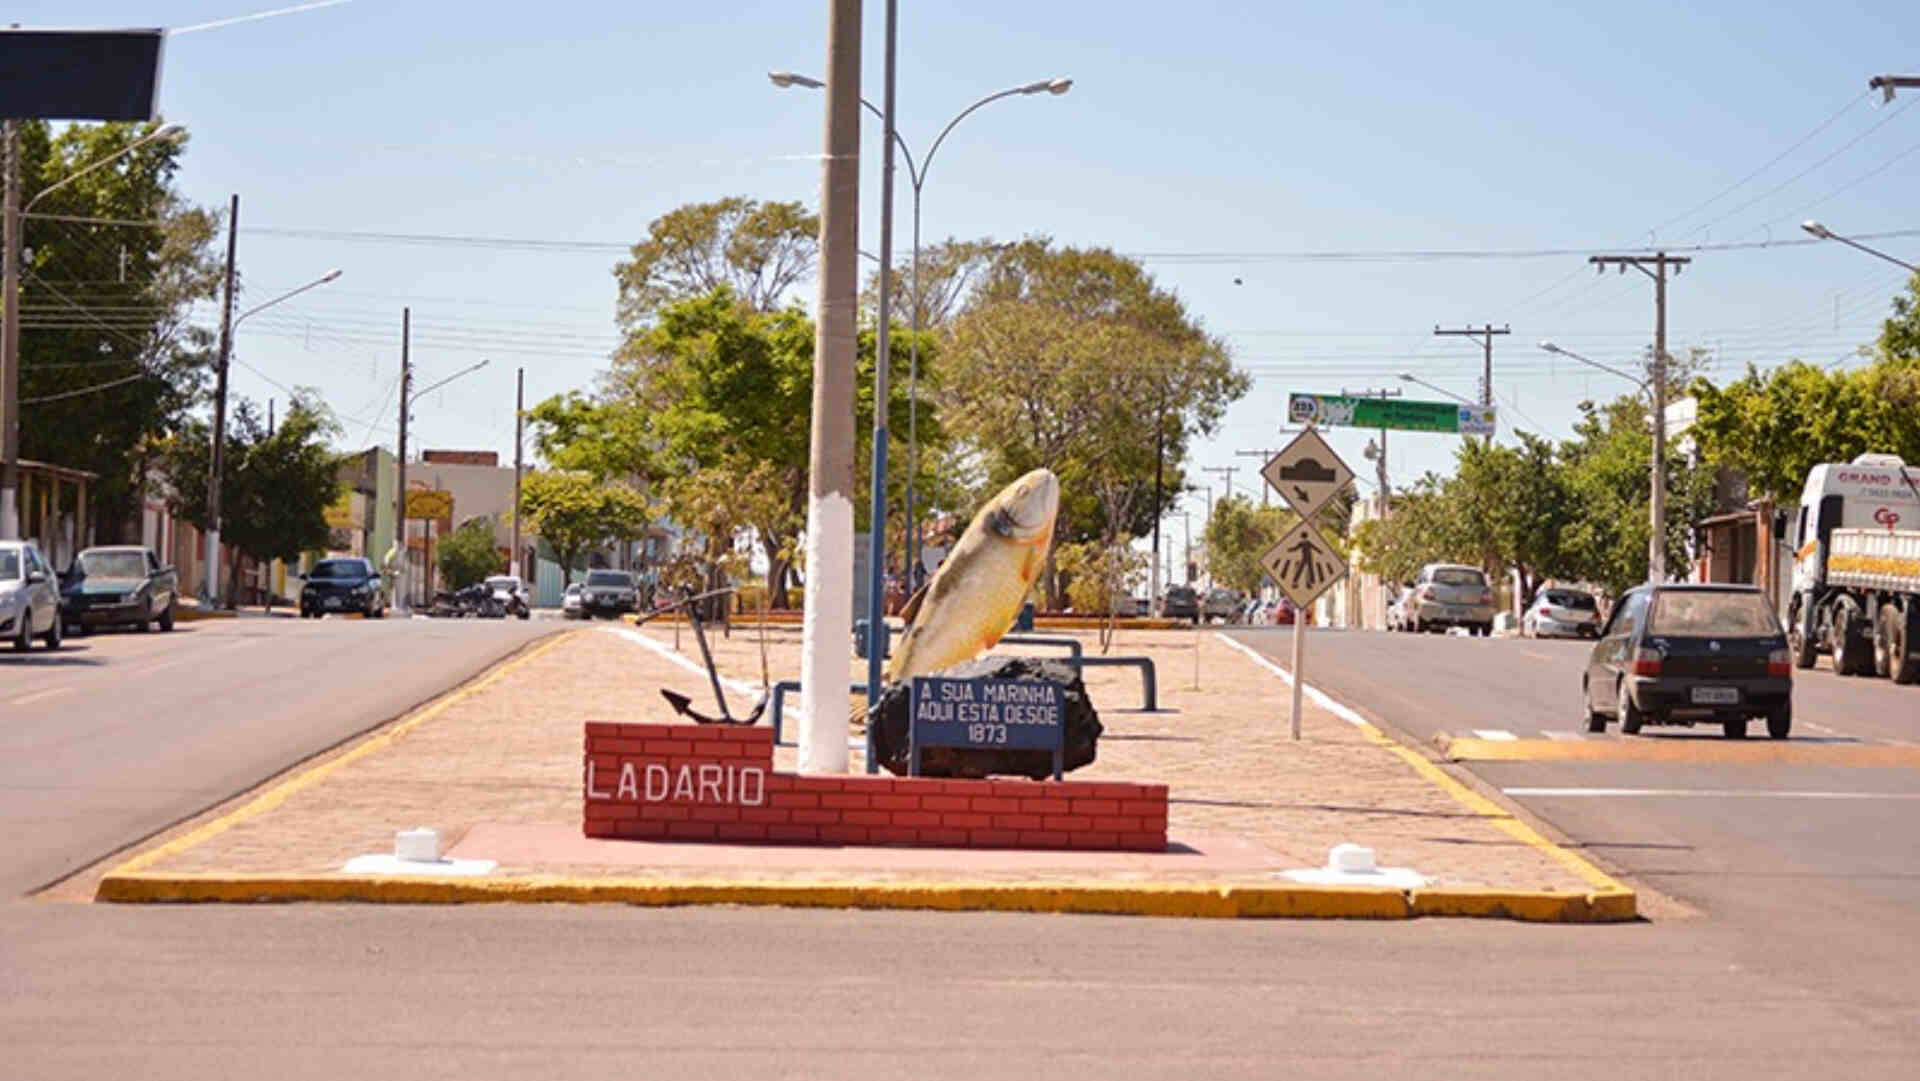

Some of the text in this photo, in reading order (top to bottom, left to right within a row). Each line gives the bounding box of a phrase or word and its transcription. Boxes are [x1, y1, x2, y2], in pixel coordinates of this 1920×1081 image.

[921, 682, 1057, 704] A SUA MARINHA
[917, 702, 1058, 725] AQUI ESTA DESDE
[968, 723, 1008, 744] 1873
[587, 760, 764, 806] LADARIO
